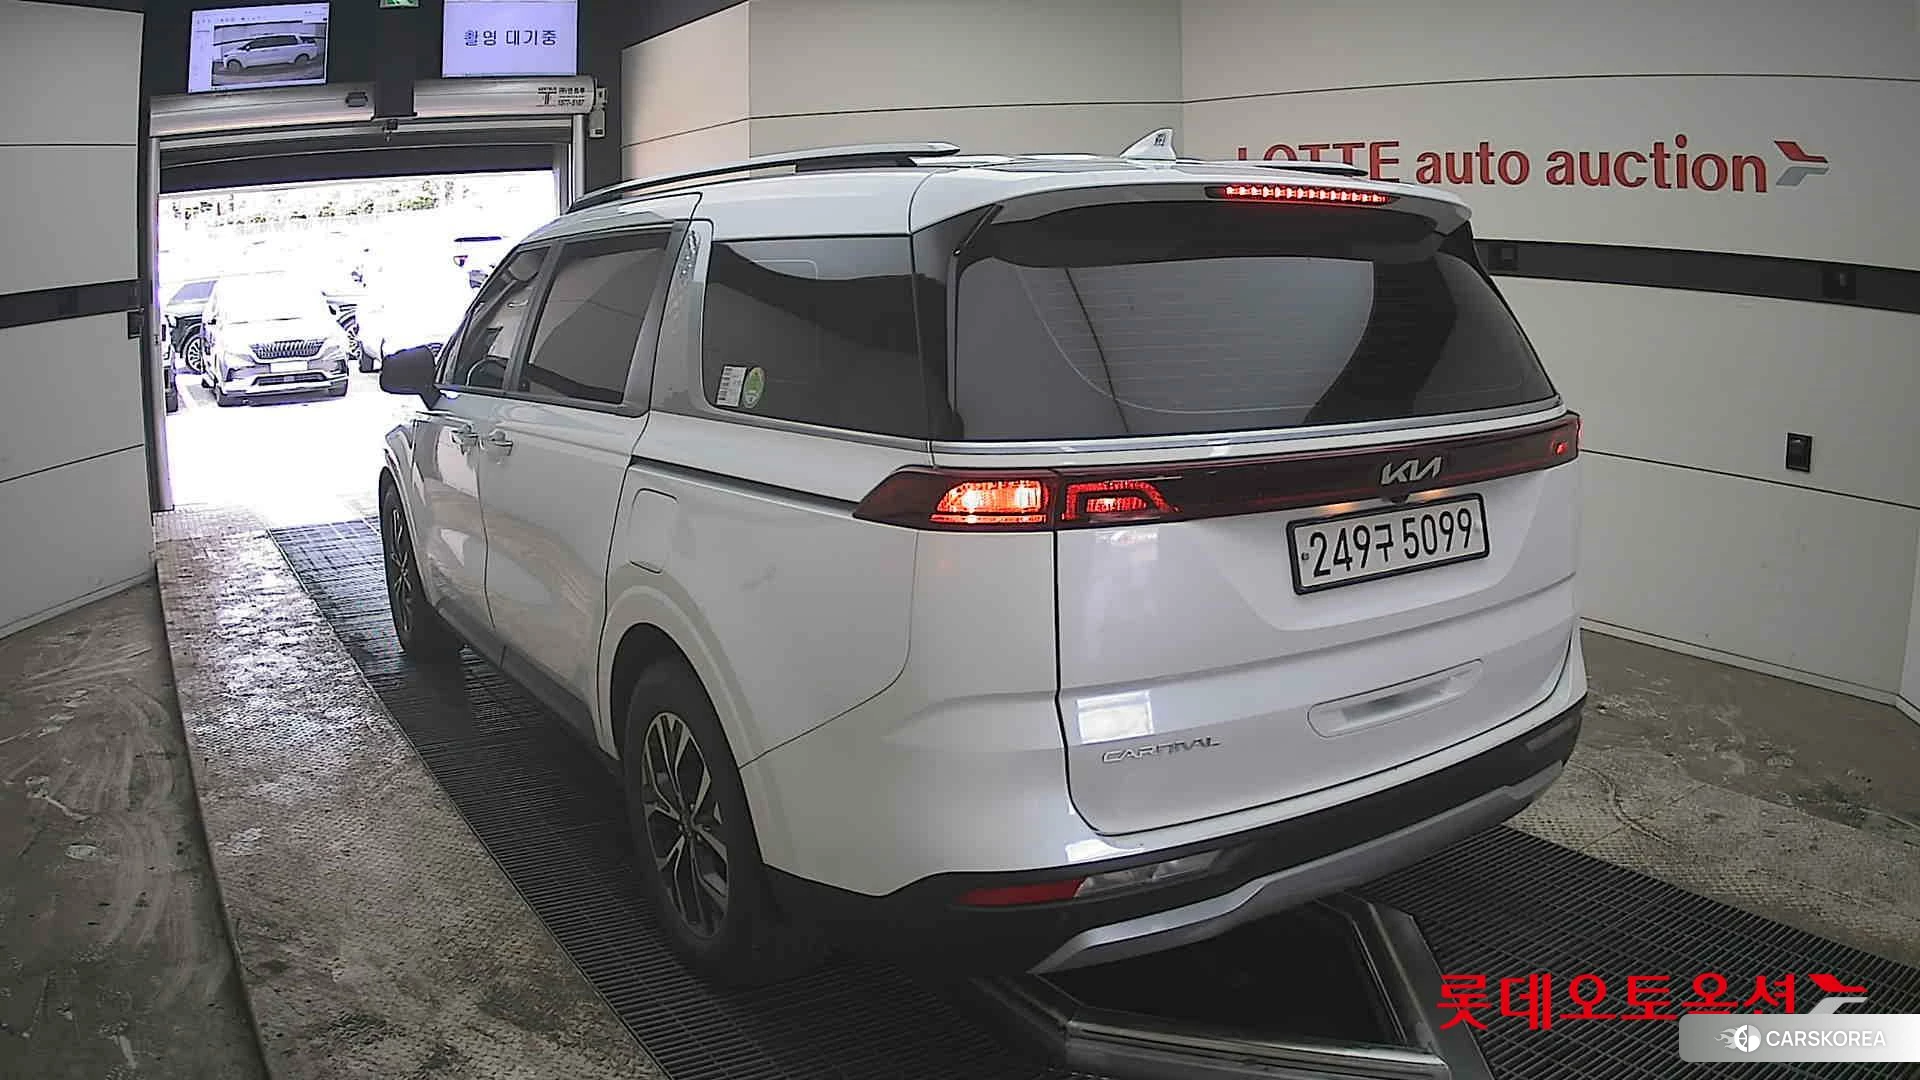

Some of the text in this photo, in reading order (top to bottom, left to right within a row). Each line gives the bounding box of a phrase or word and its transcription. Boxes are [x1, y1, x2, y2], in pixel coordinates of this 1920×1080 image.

[506, 29, 557, 46] 대기중
[1415, 141, 1530, 185] auto
[1546, 134, 1768, 193] auction
[1309, 507, 1473, 578] 249구 5099
